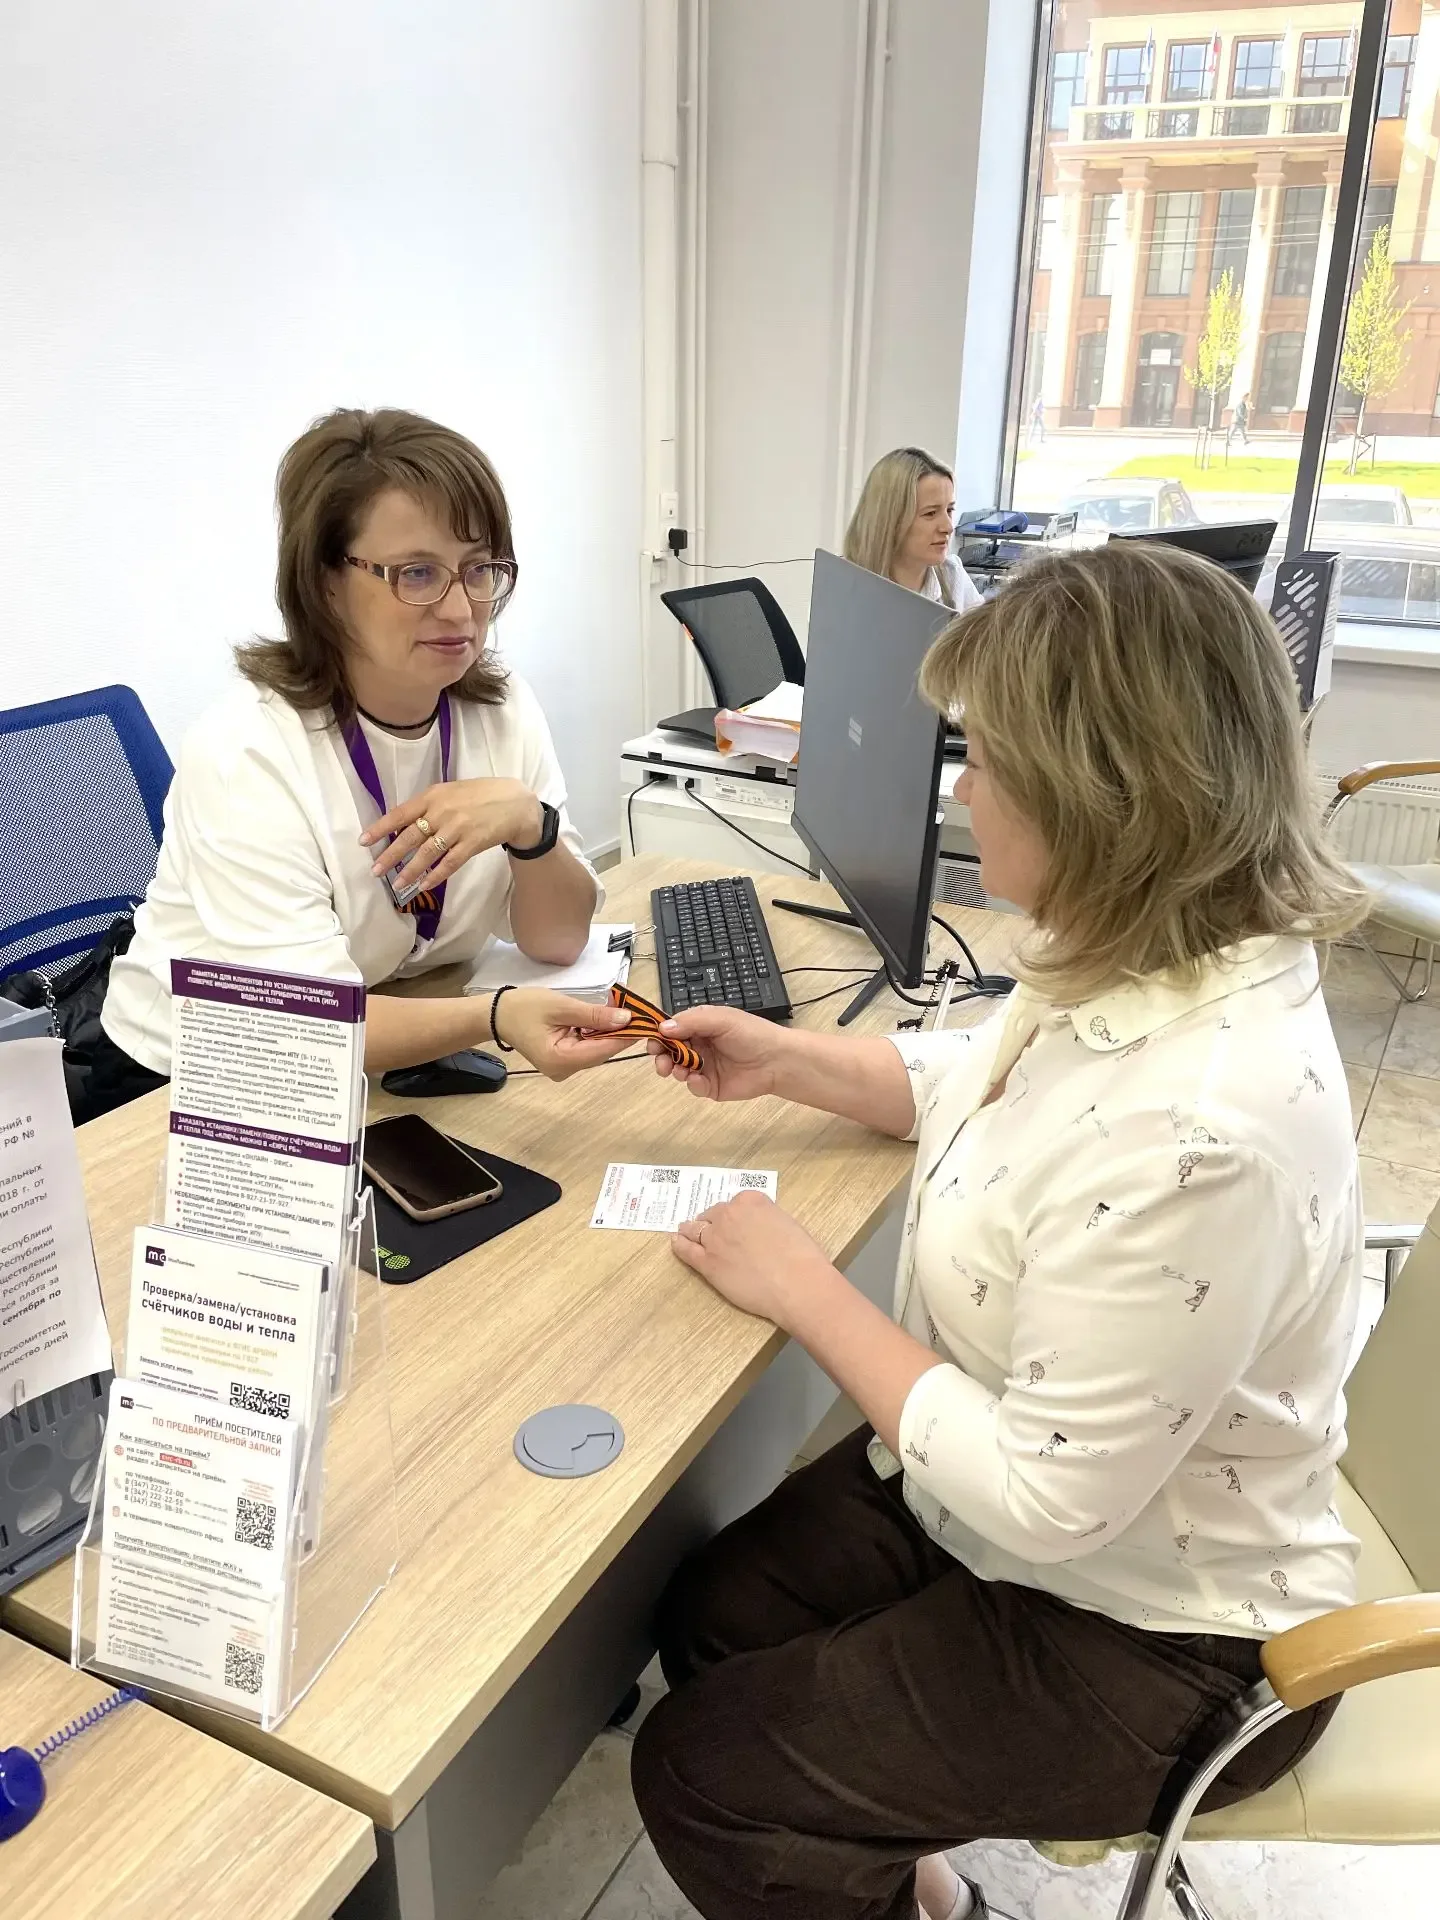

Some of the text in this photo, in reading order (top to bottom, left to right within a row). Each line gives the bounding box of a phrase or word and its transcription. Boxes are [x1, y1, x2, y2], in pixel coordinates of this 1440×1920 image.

[4, 1129, 34, 1148] РФ №
[34, 1178, 44, 1188] от
[11, 1192, 47, 1213] оплаты
[0, 1276, 59, 1313] ься плата за
[3, 1264, 58, 1298] Республики
[2, 1289, 61, 1326] сентября по
[142, 1296, 295, 1343] счётчиков воды и тепла
[143, 1281, 297, 1328] Проверка/замена/установка
[44, 1330, 69, 1351] дней
[153, 1416, 281, 1458] ПО ПРЕДВАРИТЕЛЬНОЙ ЗАПИСИ
[195, 1412, 282, 1445] ПРИЁМ ПОСЕТИТЕЛЕЙ
